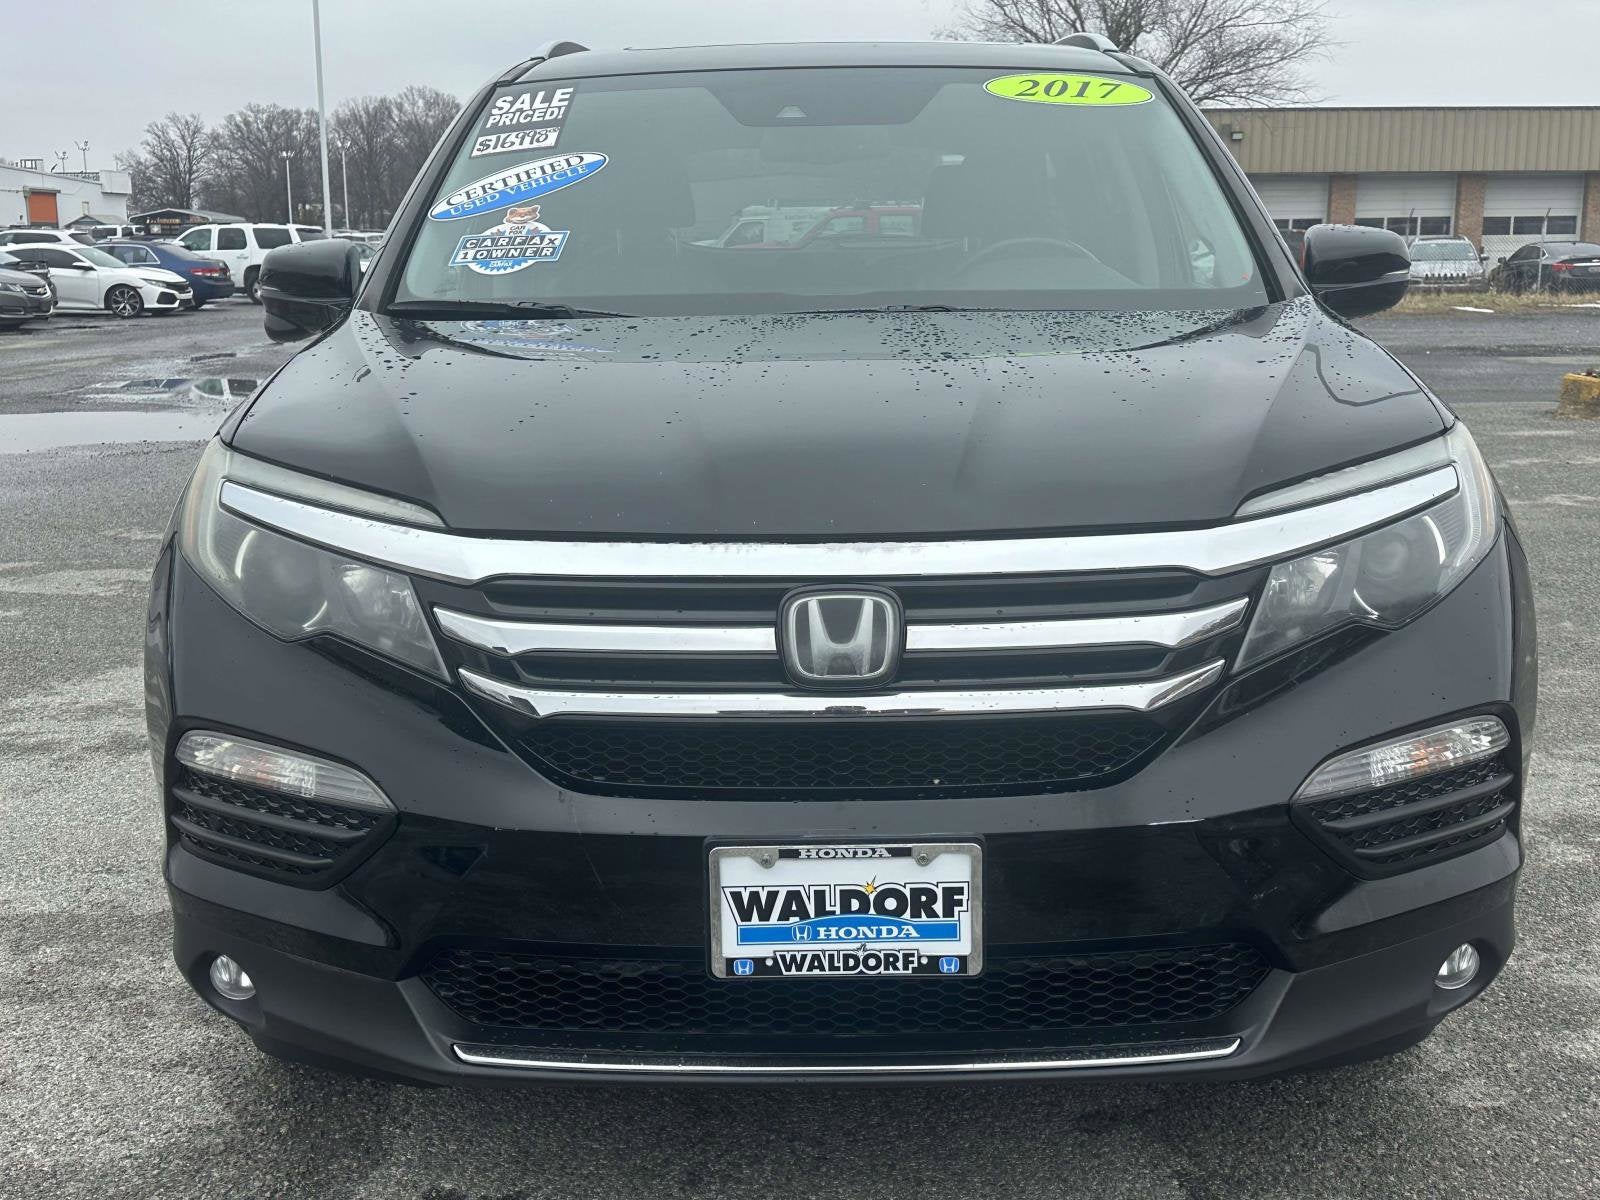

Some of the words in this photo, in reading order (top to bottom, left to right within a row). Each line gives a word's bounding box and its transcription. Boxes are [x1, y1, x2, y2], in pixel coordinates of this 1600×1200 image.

[1015, 79, 1122, 99] 2017
[491, 87, 574, 115] SALE
[486, 106, 566, 128] PRICED!
[446, 155, 585, 206] CERTIFIED
[451, 192, 500, 216] USED
[505, 164, 589, 195] VEHICLE
[460, 251, 470, 260] 1
[475, 247, 555, 259] OWNER
[466, 237, 560, 248] CARFAX
[798, 848, 892, 859] HONDA
[727, 885, 967, 923] WALDORF
[816, 925, 921, 939] HONDA
[776, 951, 917, 974] WALDORF
